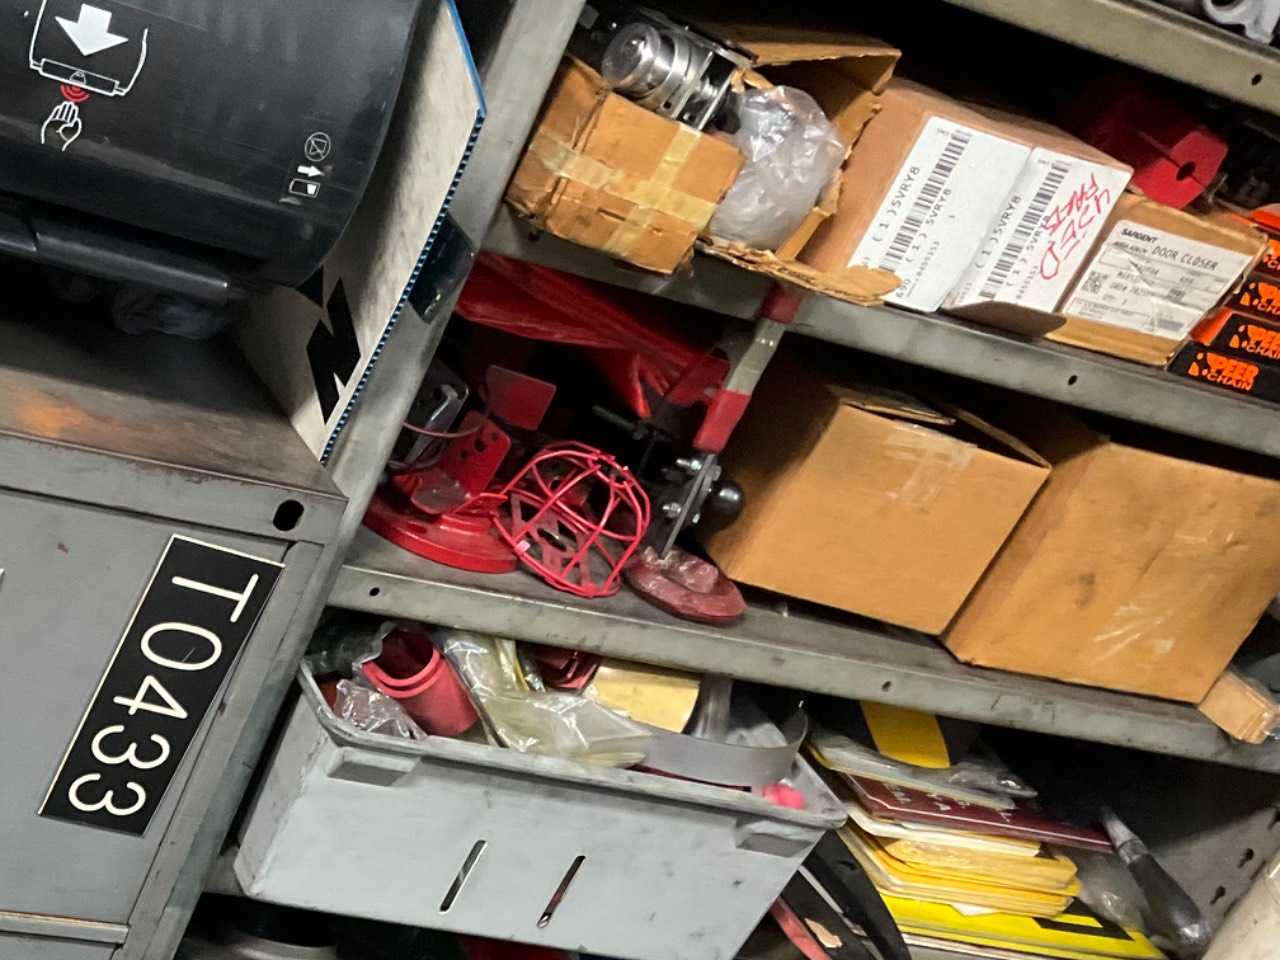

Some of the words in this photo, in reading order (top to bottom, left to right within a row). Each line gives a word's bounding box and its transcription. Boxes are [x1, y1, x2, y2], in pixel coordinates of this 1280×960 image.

[1120, 228, 1158, 243] SARGENT
[1151, 245, 1179, 261] DOOR
[1180, 253, 1219, 271] CLOSER
[1207, 373, 1254, 391] CHAIN
